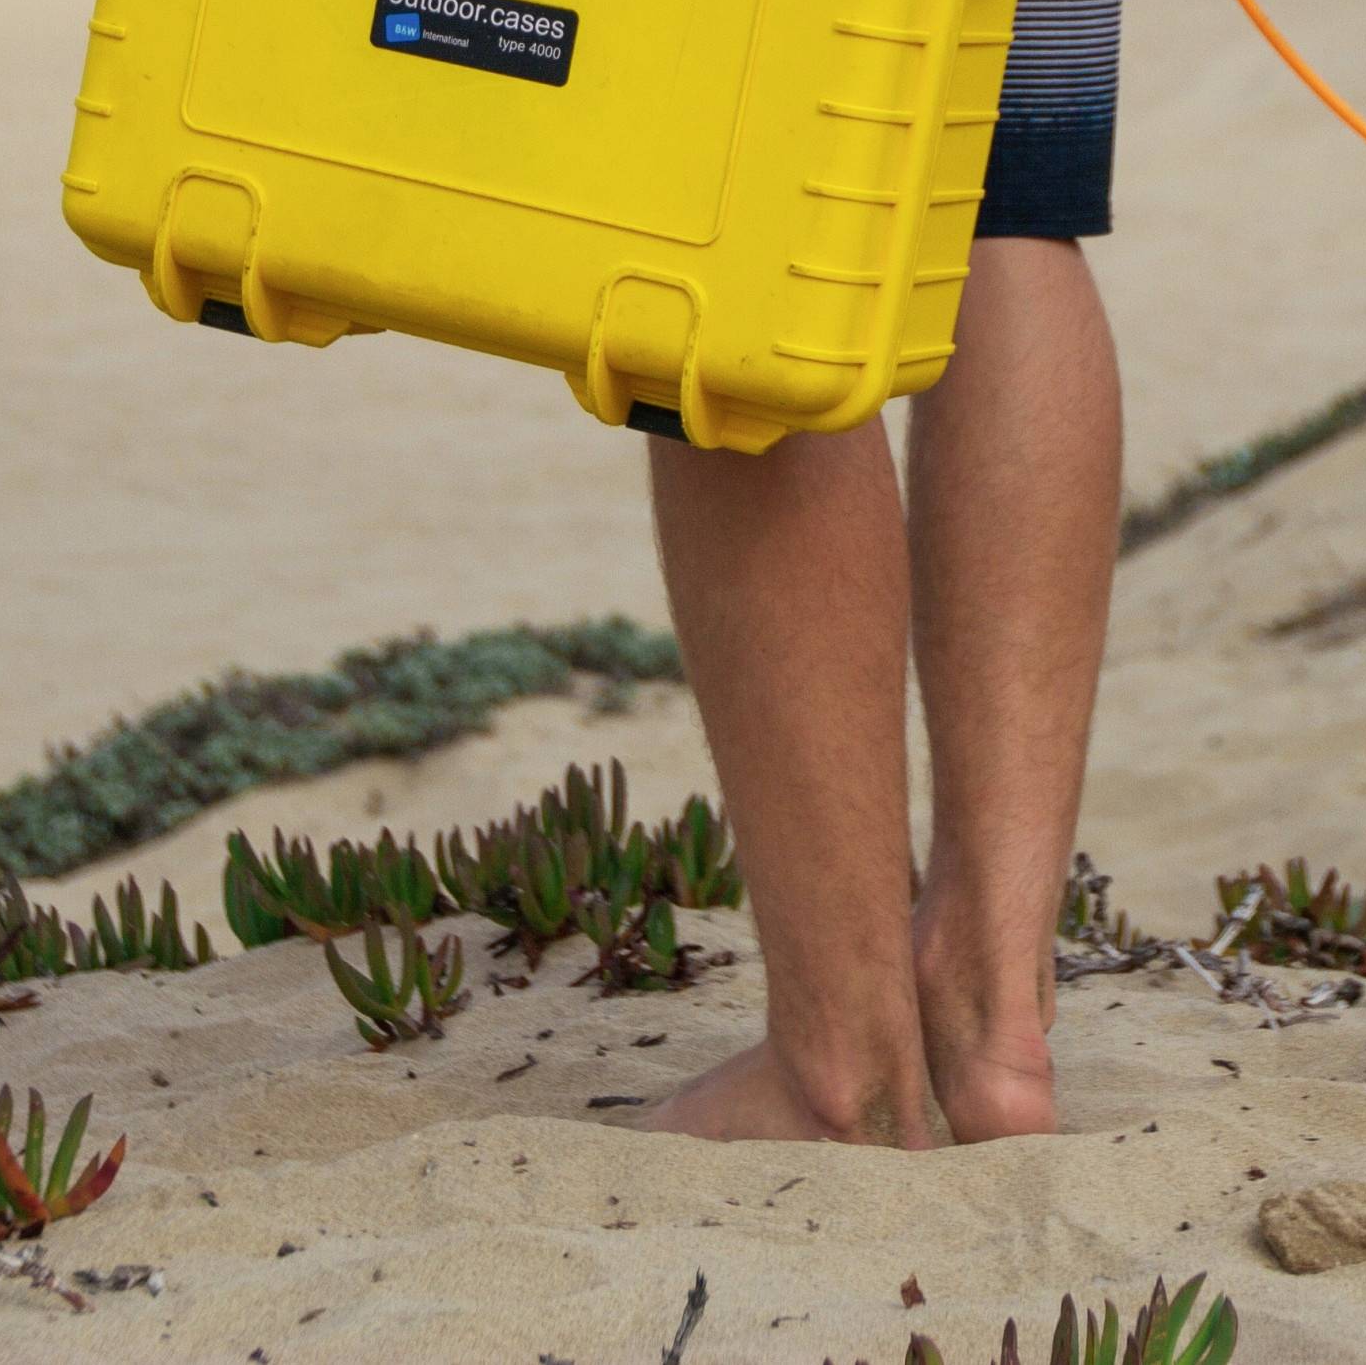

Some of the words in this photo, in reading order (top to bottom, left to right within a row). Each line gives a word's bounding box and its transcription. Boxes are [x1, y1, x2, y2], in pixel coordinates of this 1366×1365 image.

[421, 28, 470, 48] International
[497, 35, 526, 54] type
[528, 41, 562, 61] 4000
